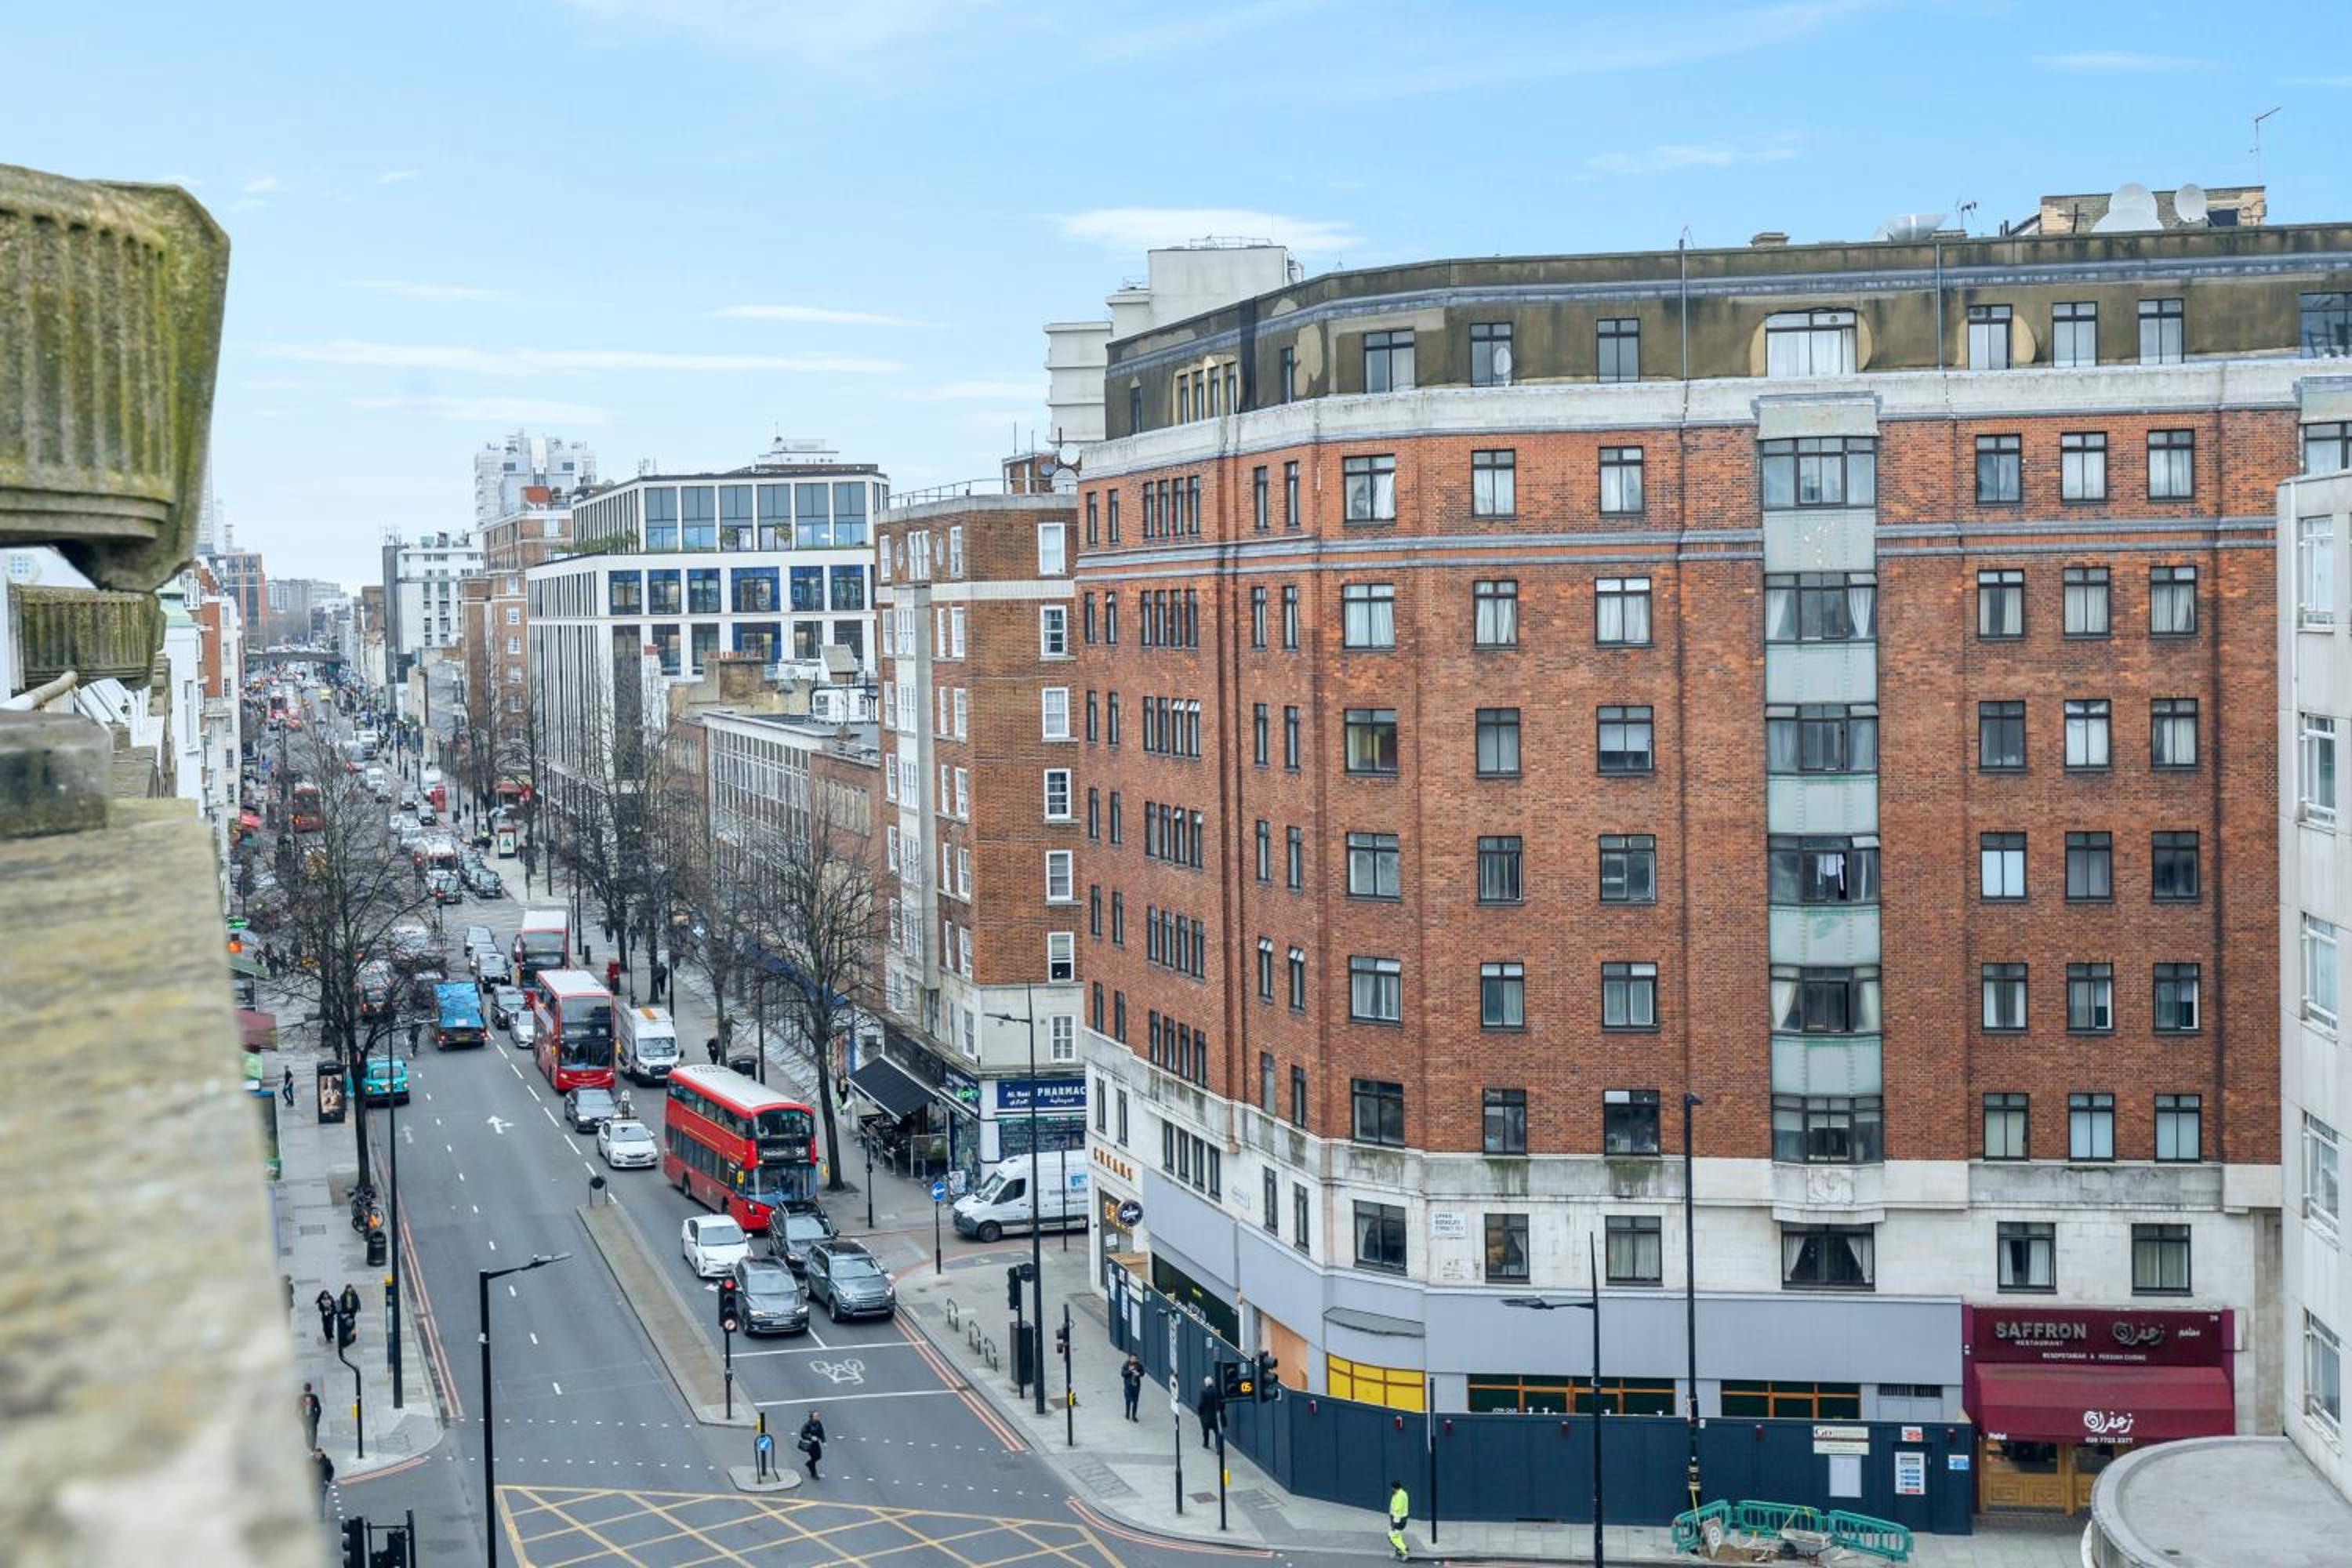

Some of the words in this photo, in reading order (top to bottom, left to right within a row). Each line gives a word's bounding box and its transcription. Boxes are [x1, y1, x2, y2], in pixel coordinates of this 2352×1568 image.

[1037, 1086, 1086, 1097] PHARMAC
[1995, 1322, 2087, 1339] SAFFRON
[1241, 1382, 1253, 1392] 05
